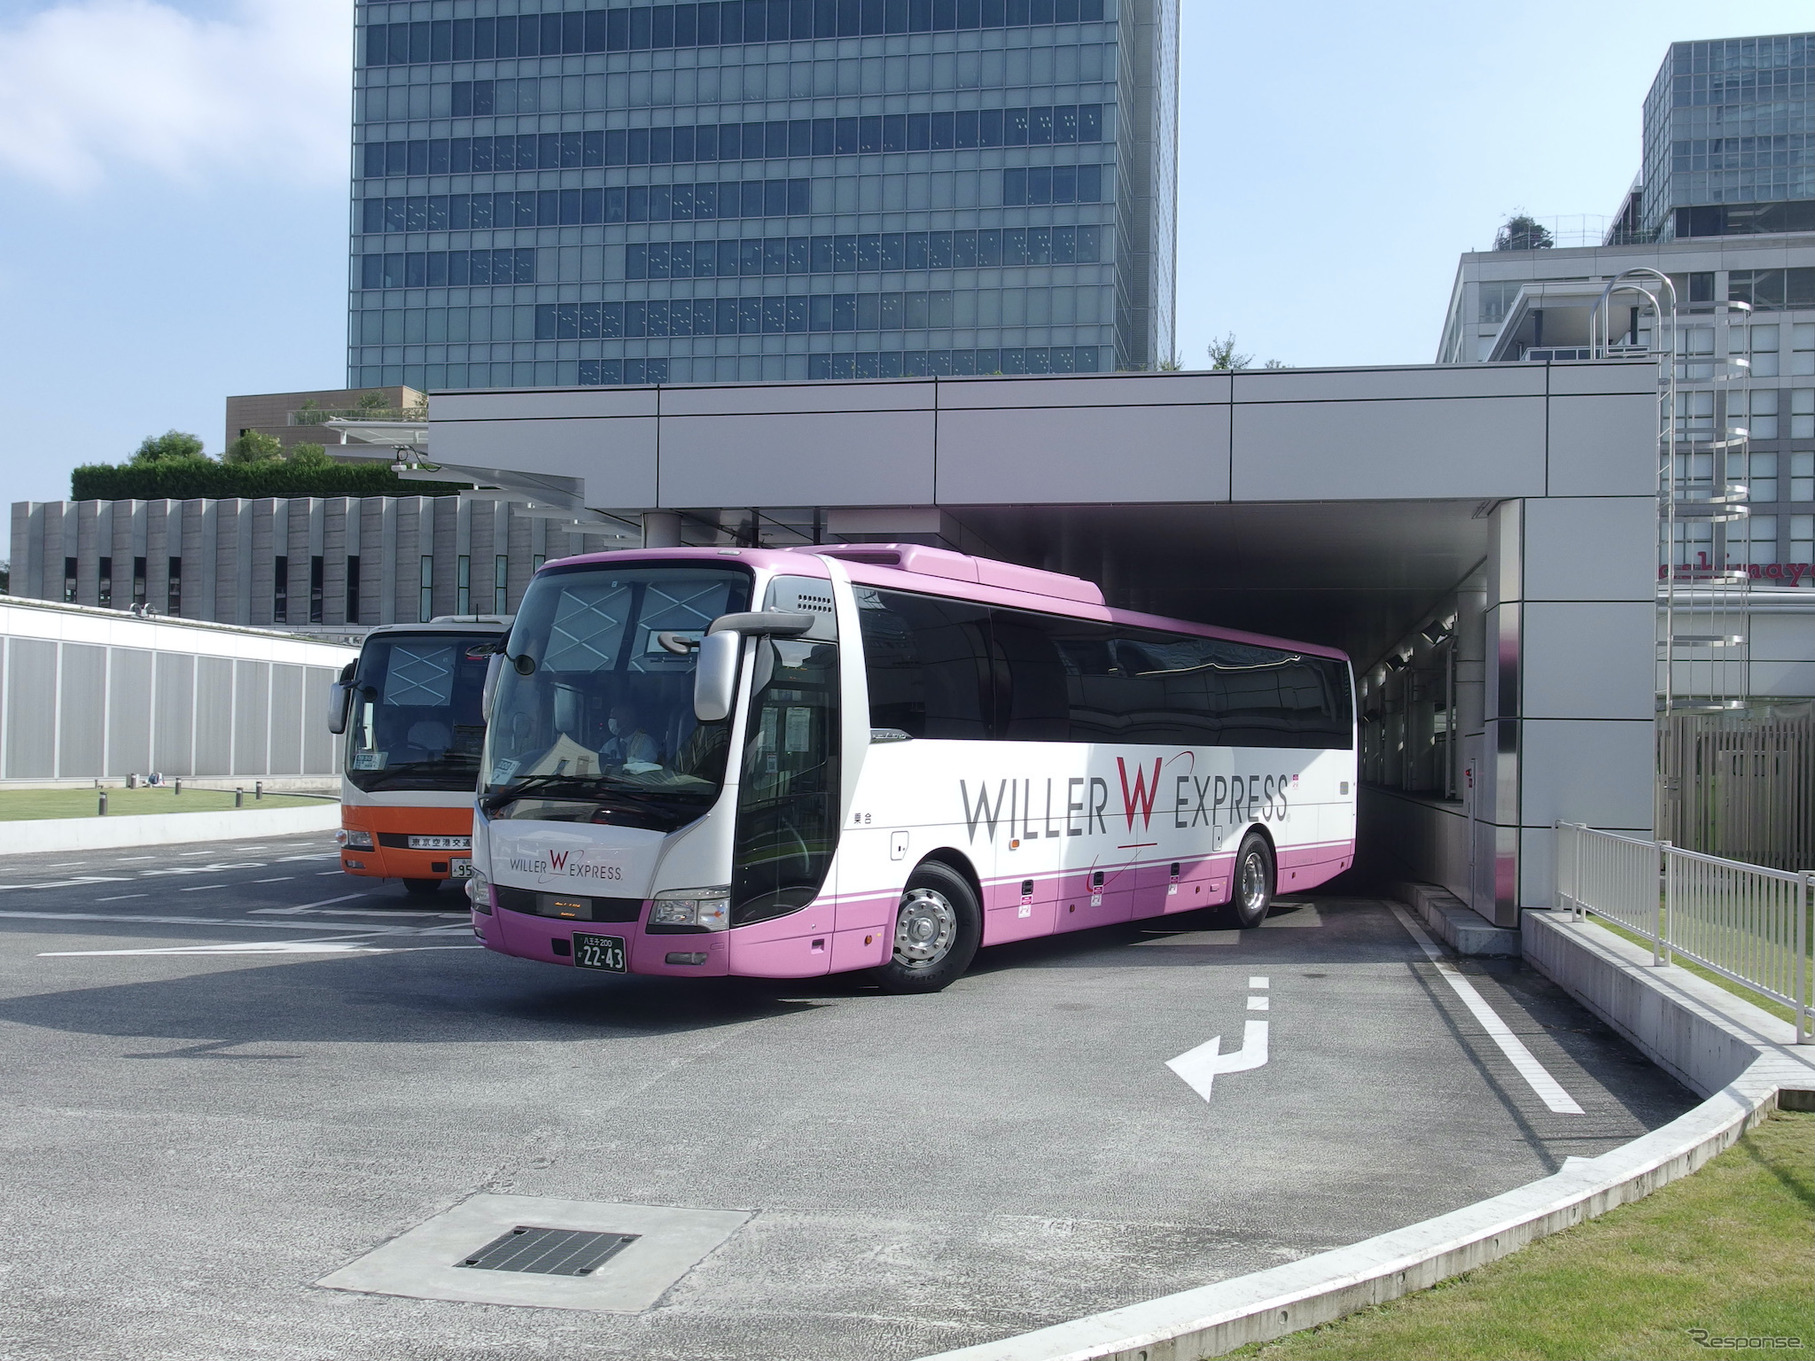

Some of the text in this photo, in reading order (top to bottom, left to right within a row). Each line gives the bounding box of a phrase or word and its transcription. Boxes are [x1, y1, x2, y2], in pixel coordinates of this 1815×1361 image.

[960, 756, 1288, 846] WILLER W EXPRESS
[411, 838, 471, 847] 東京空港交通
[510, 849, 622, 881] WILLER W EXPRESS
